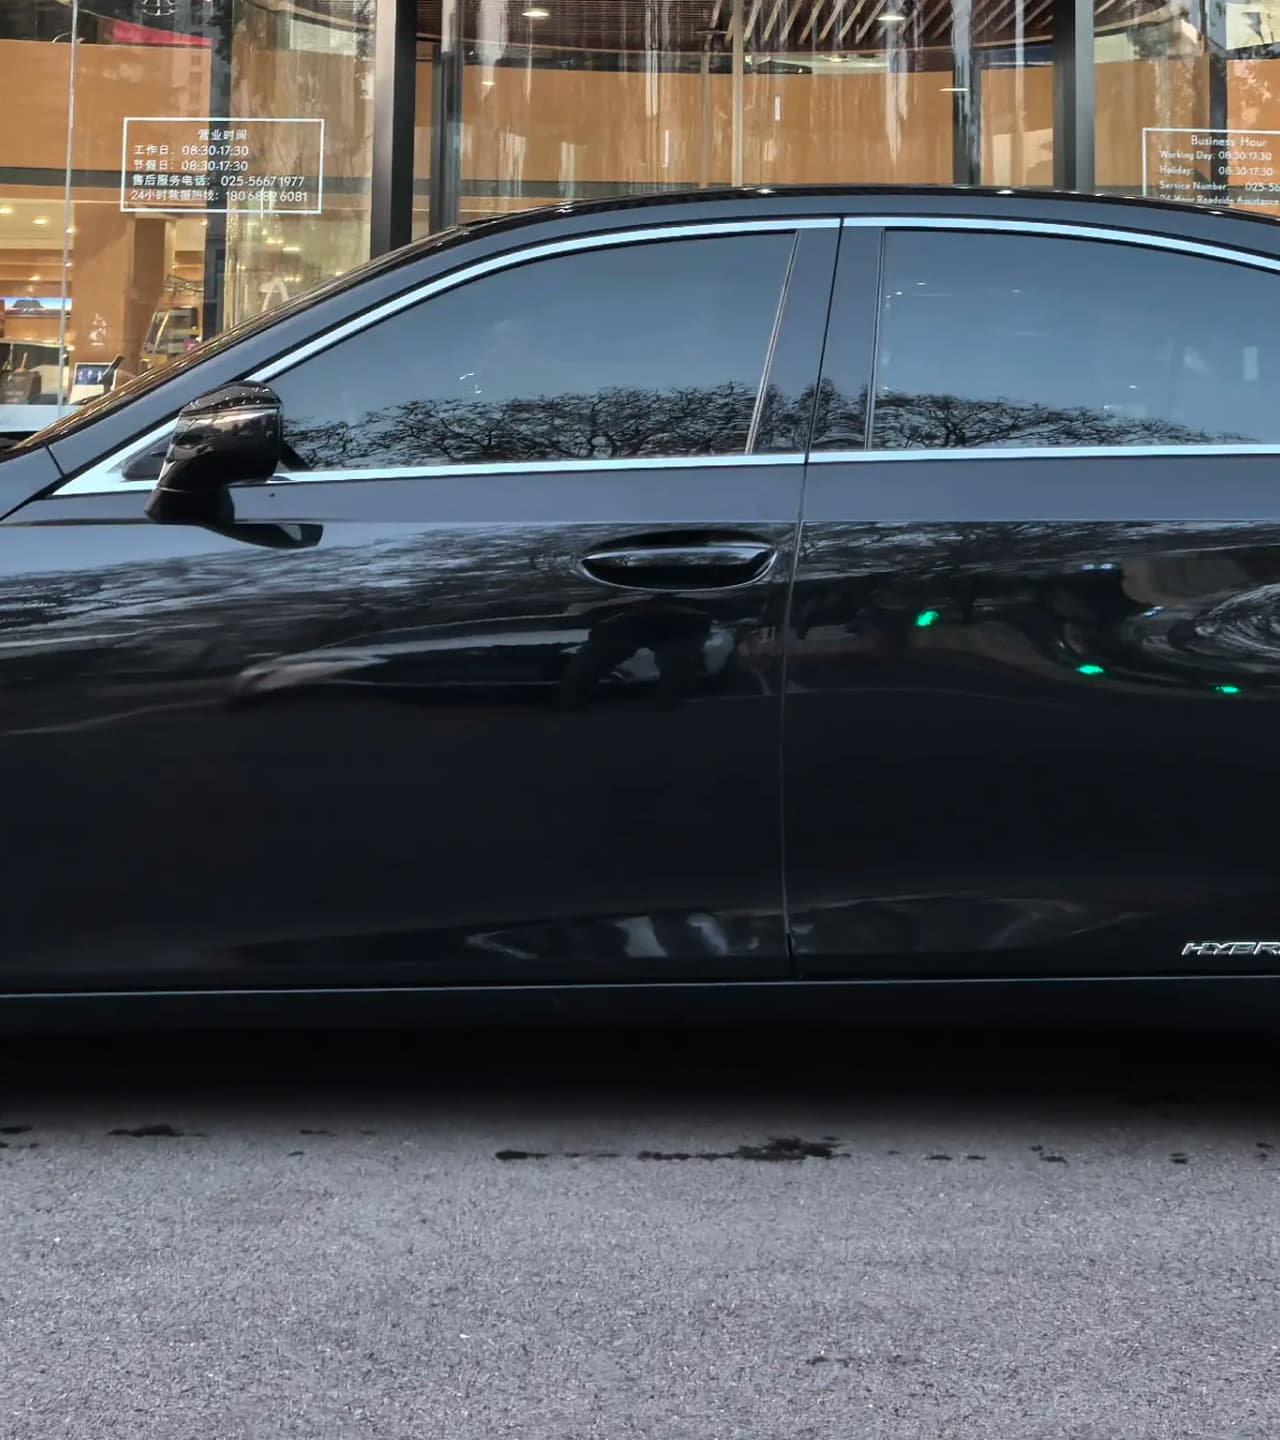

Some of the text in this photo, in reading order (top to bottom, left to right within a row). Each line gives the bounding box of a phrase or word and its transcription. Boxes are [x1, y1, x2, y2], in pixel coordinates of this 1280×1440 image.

[198, 129, 248, 142] 营业时间
[1191, 134, 1267, 148] Business Hour
[181, 144, 250, 157] 08:30-17:30
[181, 159, 249, 172] 08:30-17:30
